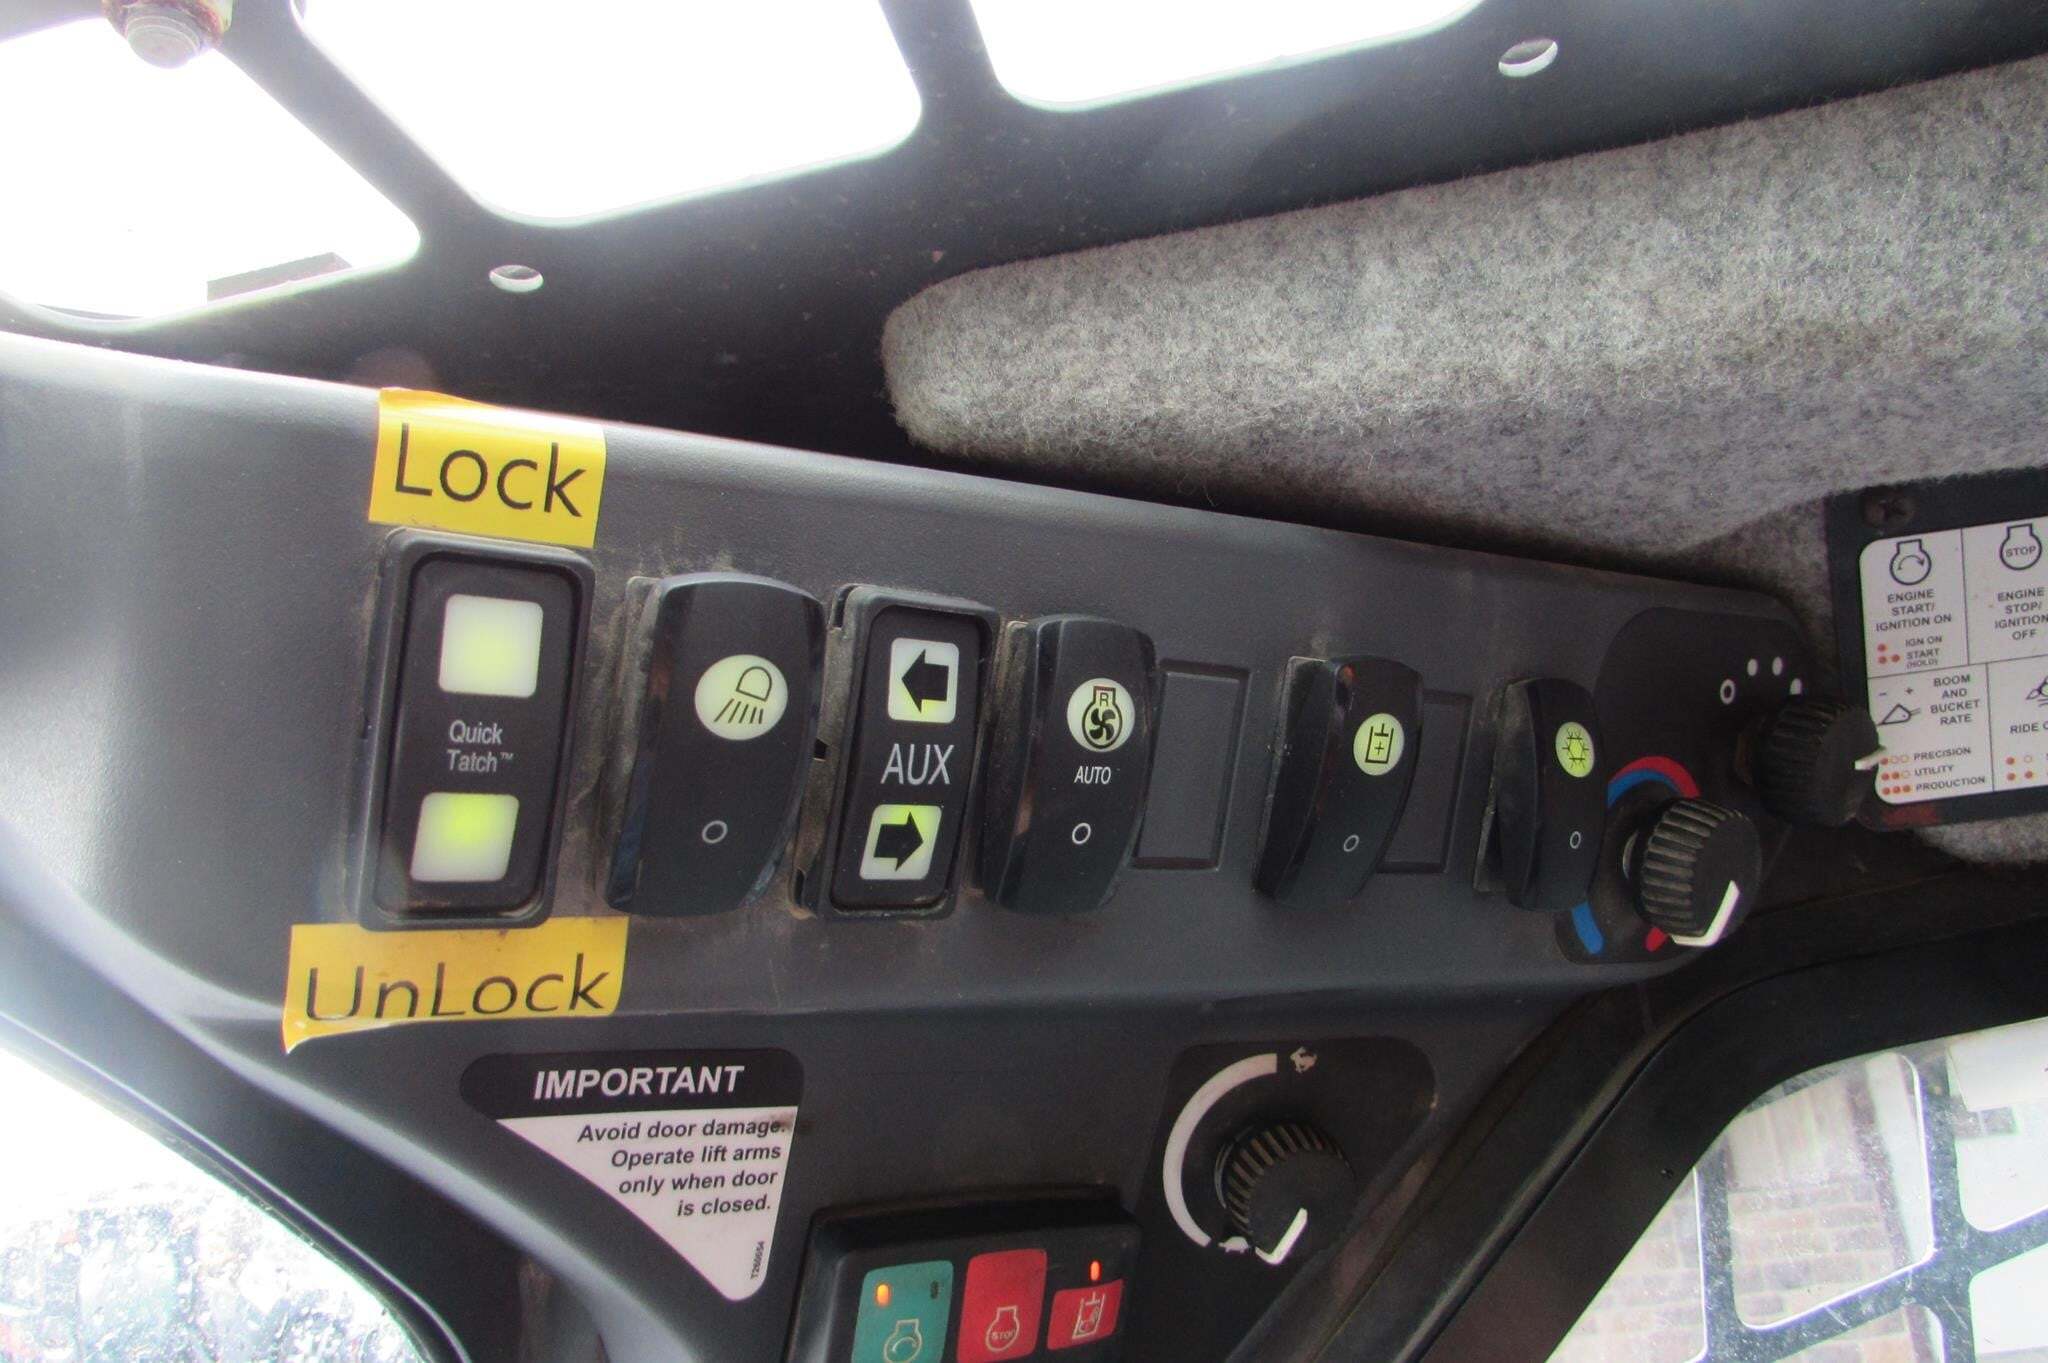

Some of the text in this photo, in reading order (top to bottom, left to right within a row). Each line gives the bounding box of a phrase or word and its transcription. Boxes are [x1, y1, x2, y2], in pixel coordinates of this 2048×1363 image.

[395, 423, 586, 517] Lock
[2005, 545, 2037, 557] STOP
[1887, 588, 1935, 603] ENGINE
[1997, 586, 2045, 602] ENGINE
[1891, 601, 1936, 616] START/
[2005, 601, 2042, 614] STOP/
[1876, 613, 1952, 632] IGNITION ON
[1994, 614, 2048, 629] IGNITION
[1905, 635, 1942, 648] IGN ON
[2011, 628, 2037, 641] OFF
[1906, 648, 1940, 660] START
[1933, 674, 1971, 688] BOOM
[1942, 688, 1967, 699] AND
[1930, 699, 1980, 714] BUCKET
[1940, 713, 1972, 726] RATE
[449, 719, 503, 745] Quick
[2010, 722, 2039, 735] RIDE
[1913, 746, 1972, 761] PRECISION
[881, 743, 954, 785] AUX
[1914, 764, 1954, 777] UTILITY
[1074, 765, 1112, 784] AUTO
[1916, 775, 1986, 792] PRODUCTION
[305, 952, 610, 1021] UnLock
[533, 1065, 745, 1100] IMPORTANT
[577, 1117, 786, 1143] Avoid door damage.
[610, 1145, 781, 1171] Operate lift arms
[618, 1170, 779, 1196] only when door
[676, 1194, 771, 1217] is closed.
